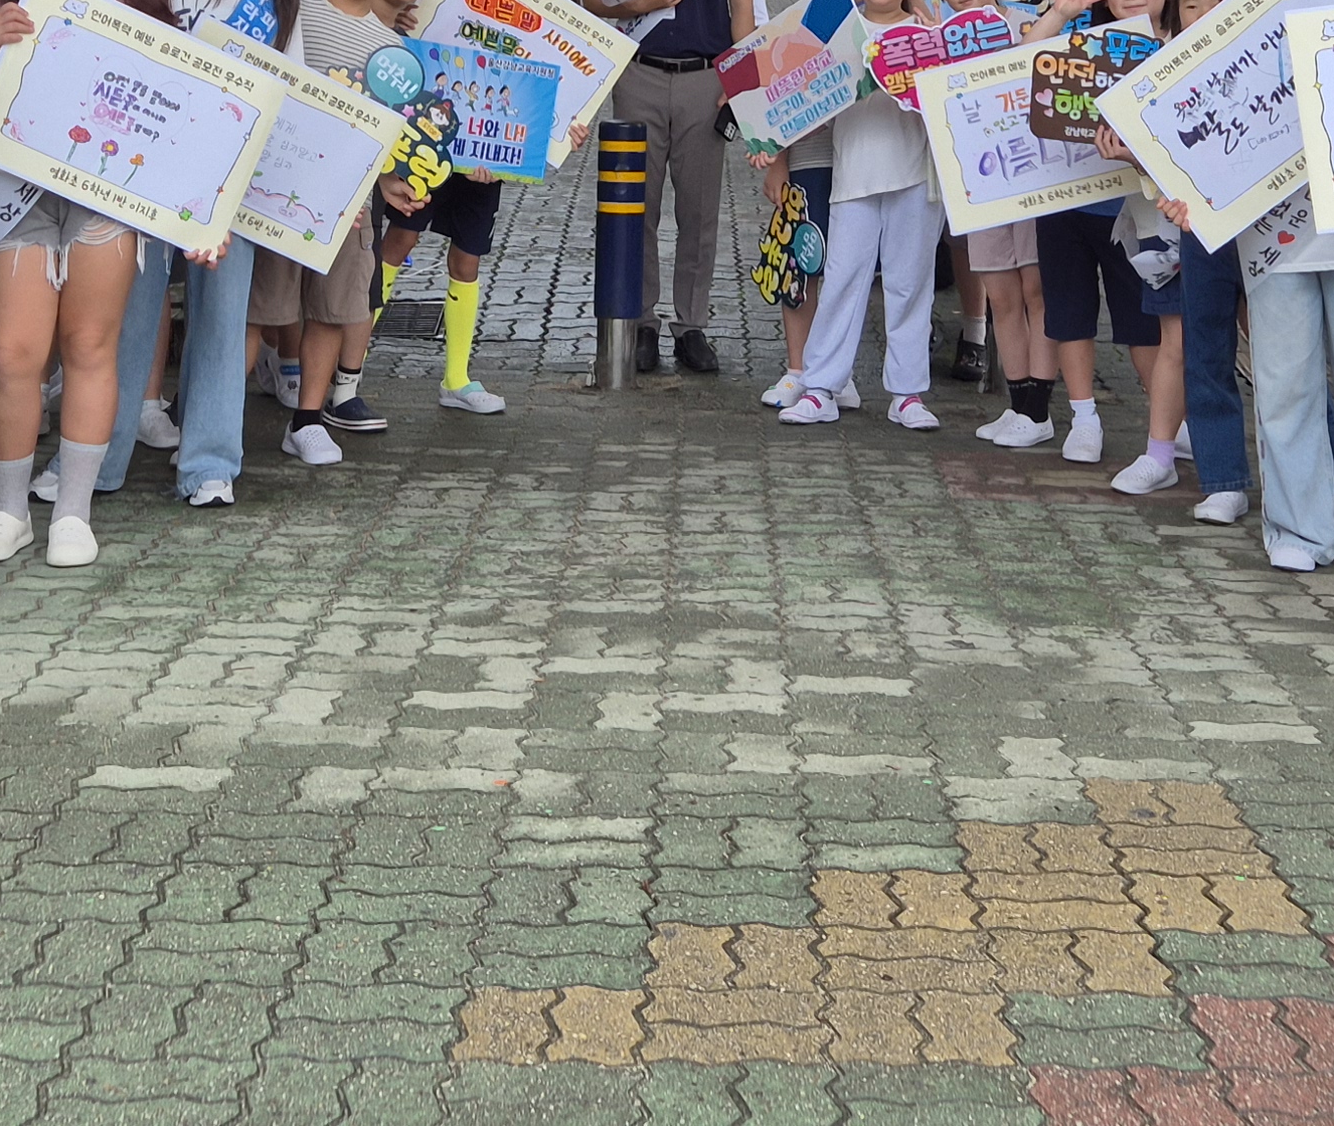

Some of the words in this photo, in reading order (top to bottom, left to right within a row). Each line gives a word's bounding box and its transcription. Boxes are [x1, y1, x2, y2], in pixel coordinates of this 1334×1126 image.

[544, 1, 569, 19] 슬로건
[567, 14, 591, 34] 공모전
[591, 30, 615, 50] 우수작
[91, 9, 133, 36] 언어폭력
[134, 29, 156, 47] 예방
[160, 42, 192, 64] 슬로건
[192, 56, 223, 79] 공모전
[225, 71, 255, 93] 우수작
[542, 29, 599, 77] 사이에서
[1154, 49, 1193, 81] 언어폭력
[1192, 34, 1213, 53] 예방
[1215, 10, 1244, 37] 슬로건
[377, 55, 418, 99] 멈춰!
[765, 67, 806, 104] 따뜻한
[804, 48, 835, 75] 학교
[808, 62, 852, 97] 우리가
[301, 82, 329, 102] 슬로건
[328, 93, 354, 116] 공모전
[354, 109, 380, 129] 우수작
[779, 85, 853, 140] 만들어보자!
[961, 98, 982, 124] 날
[468, 117, 499, 138] 너와
[504, 122, 526, 142] 나!
[471, 142, 522, 166] 지내자!
[49, 167, 78, 188] 영화초
[81, 180, 111, 202] 6학년
[1048, 186, 1075, 203] 6학년
[1267, 166, 1296, 191] 영화초
[247, 216, 264, 232] 6반
